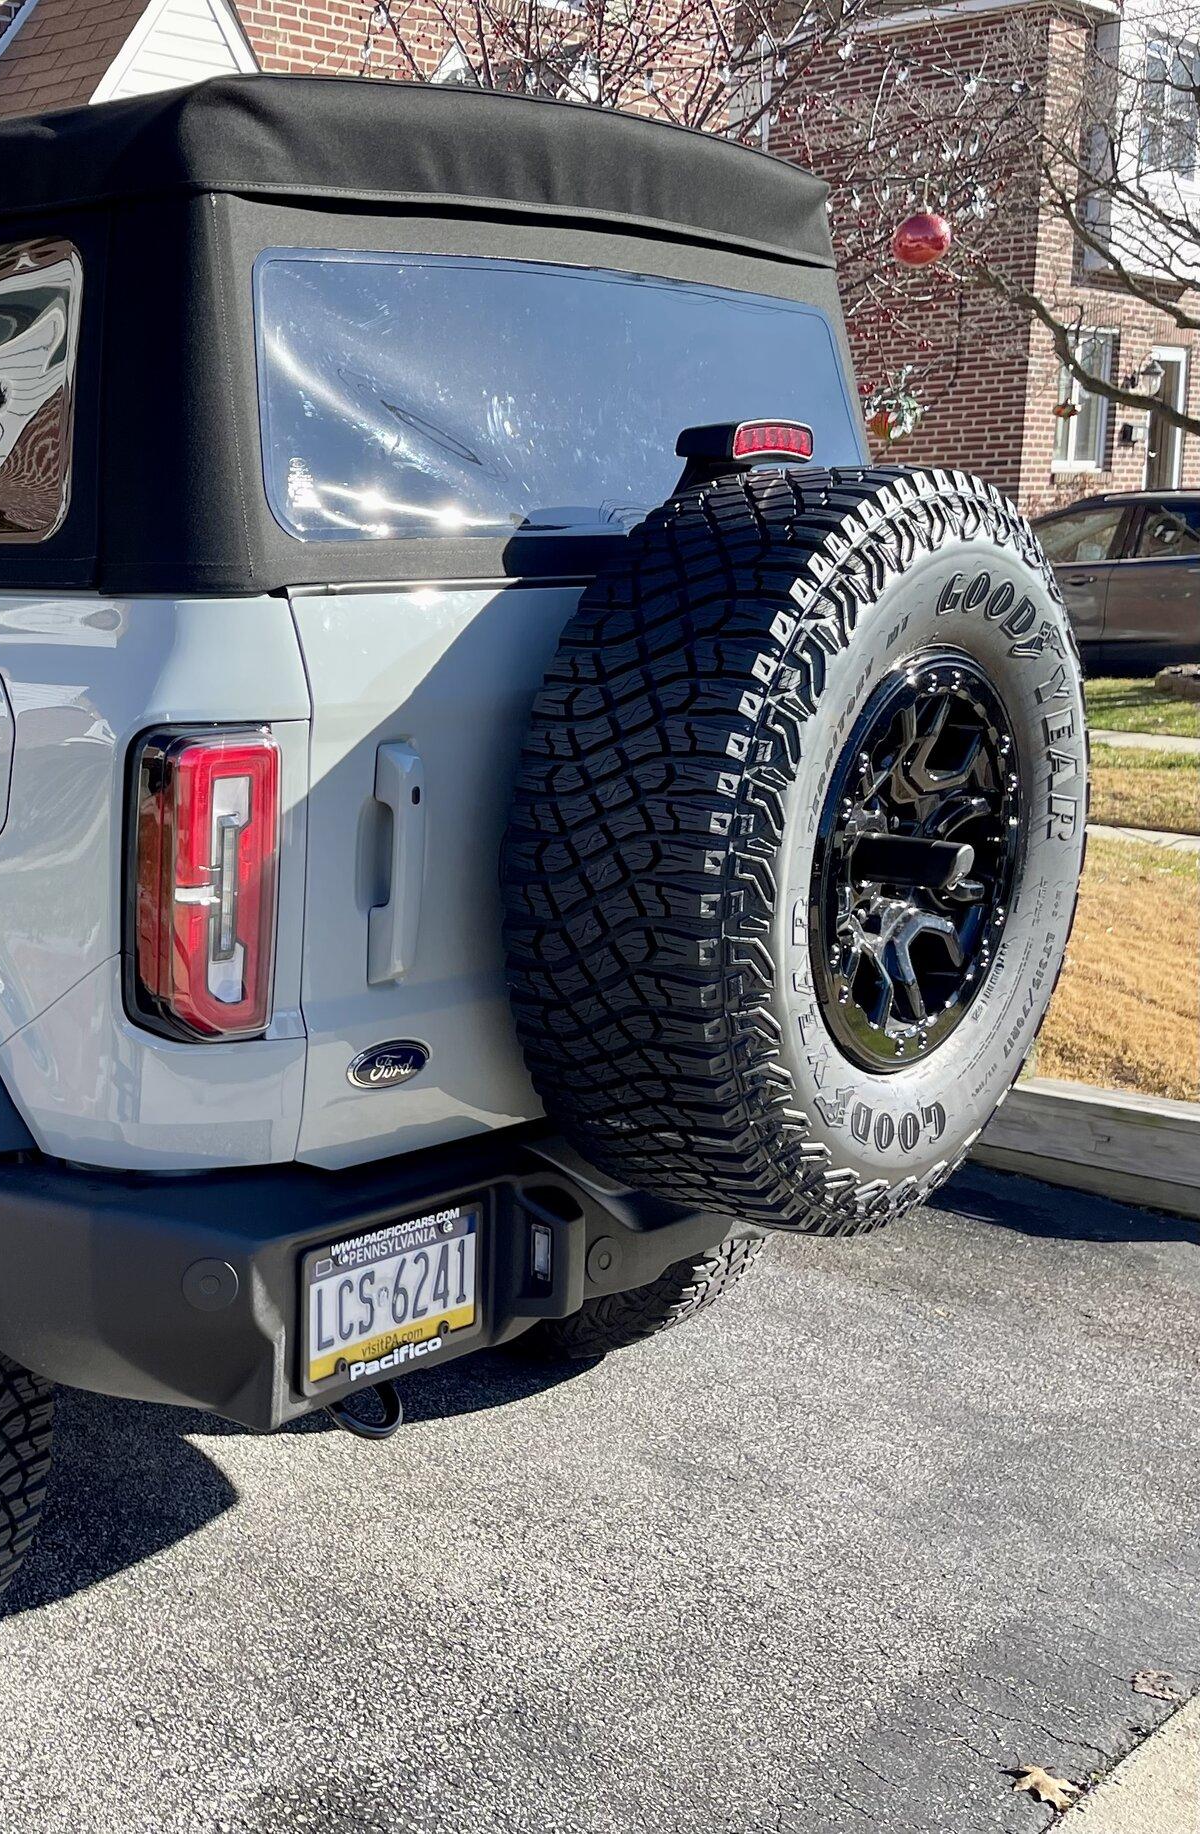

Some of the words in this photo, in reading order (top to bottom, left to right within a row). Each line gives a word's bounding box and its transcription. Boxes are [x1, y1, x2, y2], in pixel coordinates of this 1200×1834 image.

[936, 571, 1078, 841] GOODYEAR
[369, 1054, 414, 1081] Ford
[330, 1207, 460, 1256] WWW.PACIFICOCARS.COM
[349, 1230, 437, 1266] PENNSYLVANIA
[316, 1271, 376, 1351] LCS
[391, 1238, 467, 1325] 6241
[349, 1337, 443, 1381] Pacifico
[361, 1326, 423, 1357] visitPA.com
